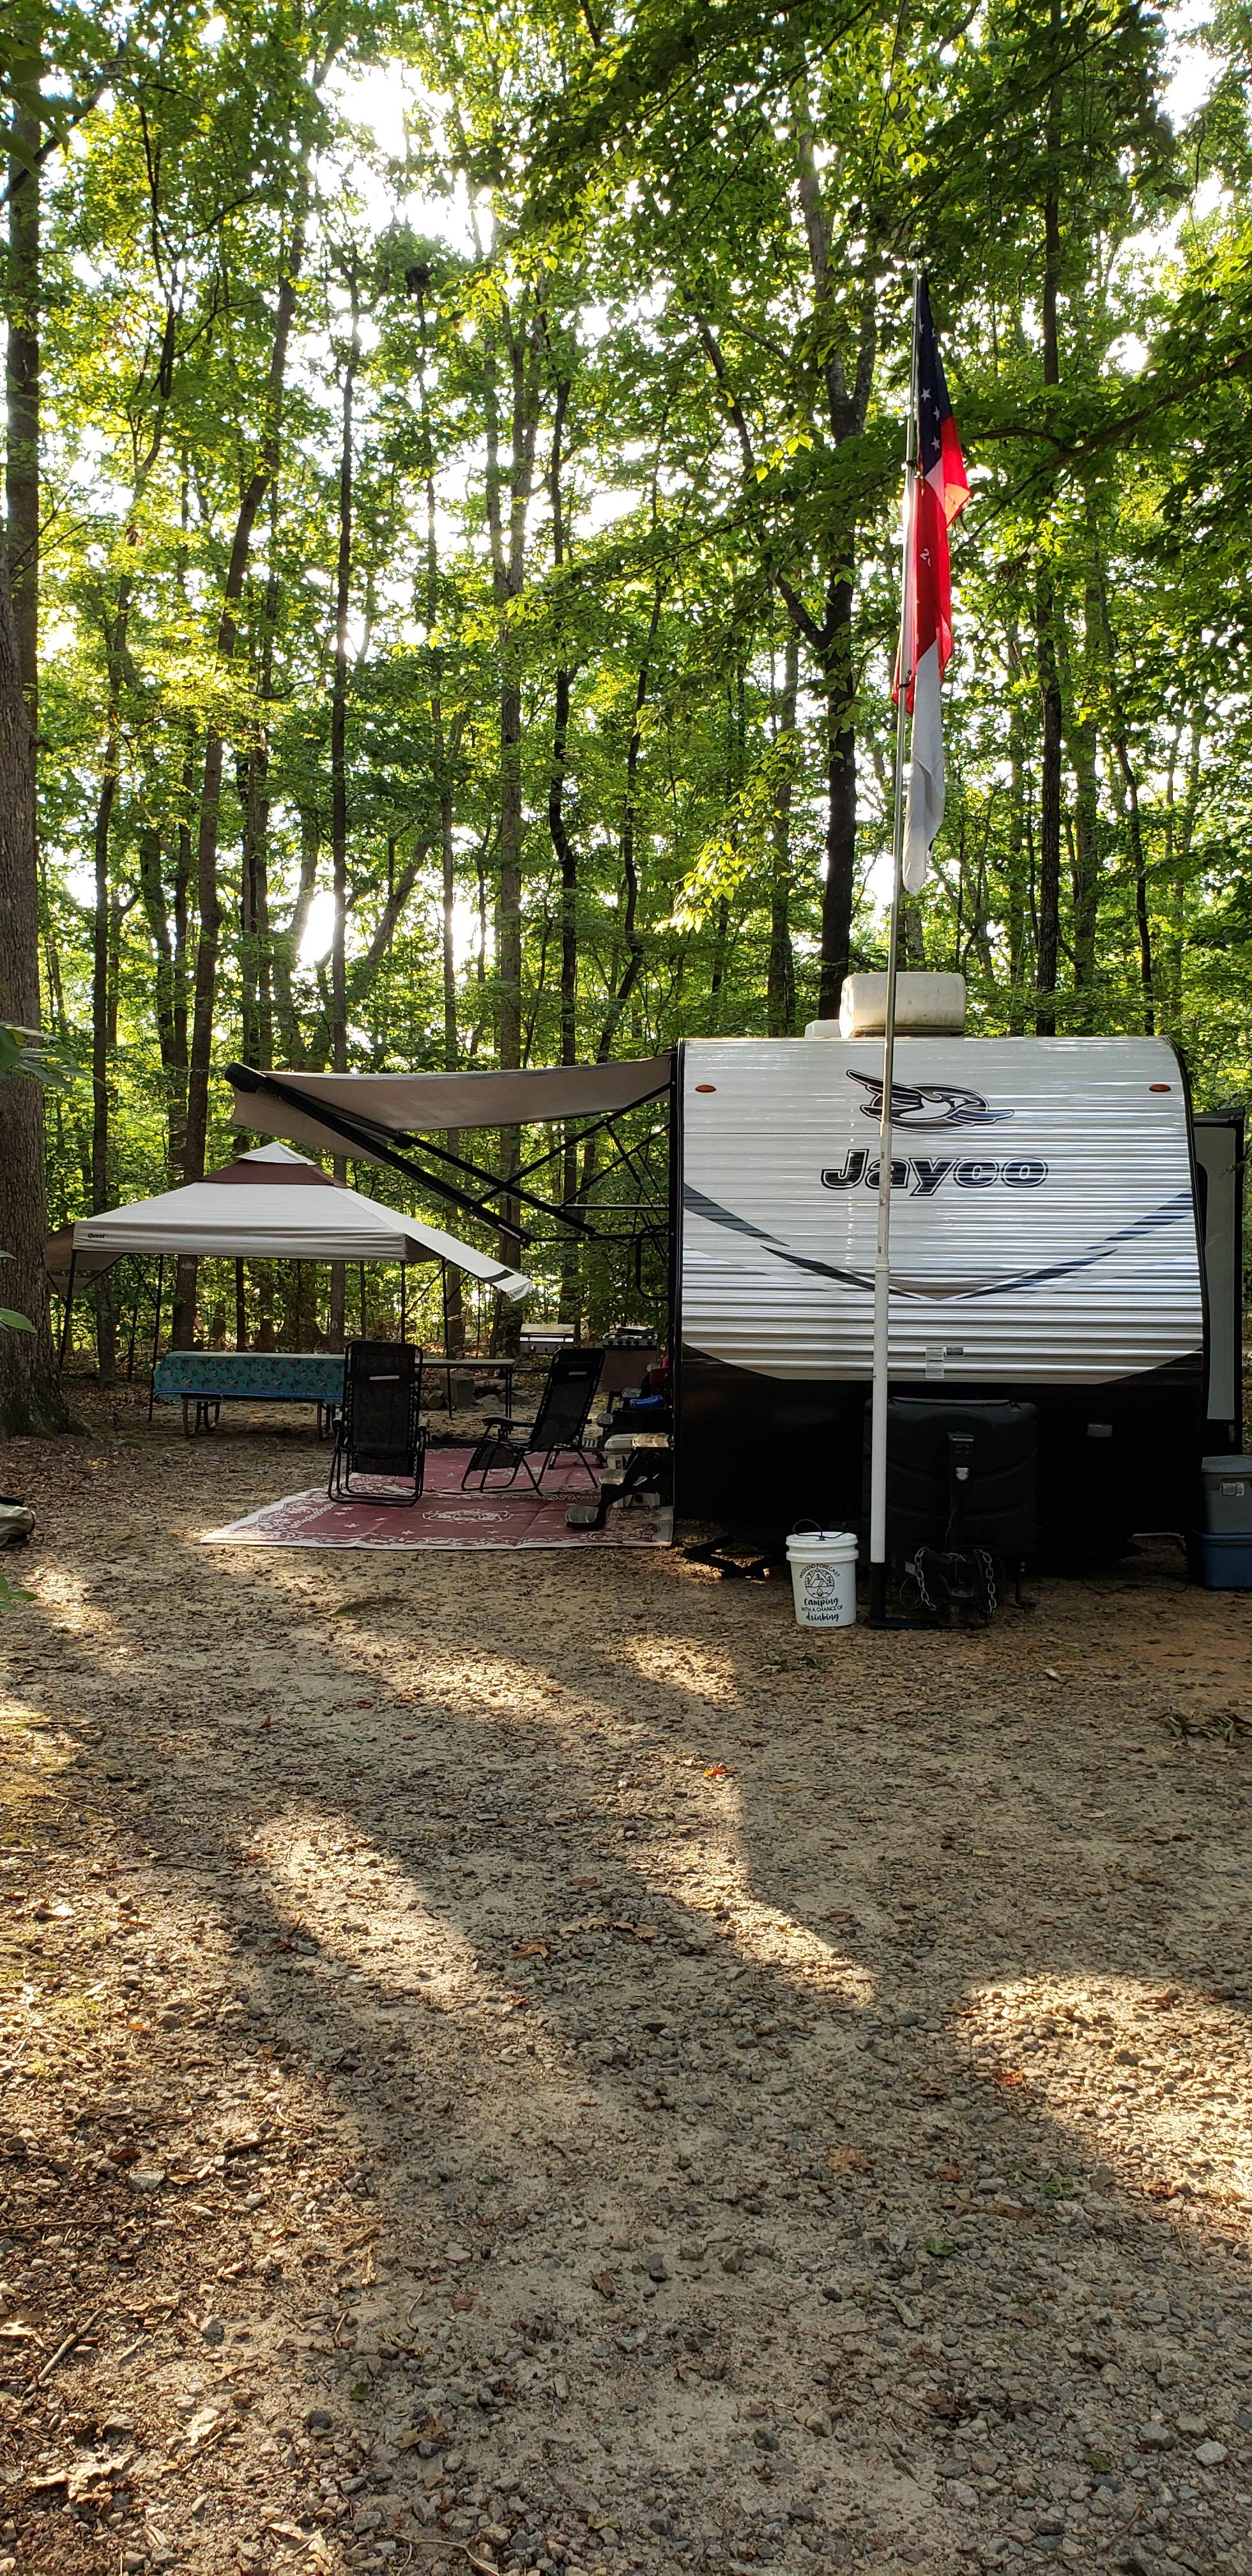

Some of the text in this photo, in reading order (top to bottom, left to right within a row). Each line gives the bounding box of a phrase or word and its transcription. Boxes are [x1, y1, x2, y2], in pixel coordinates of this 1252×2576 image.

[821, 1149, 1048, 1196] Jayco
[804, 1597, 838, 1607] Camping
[806, 1612, 839, 1622] drinking
